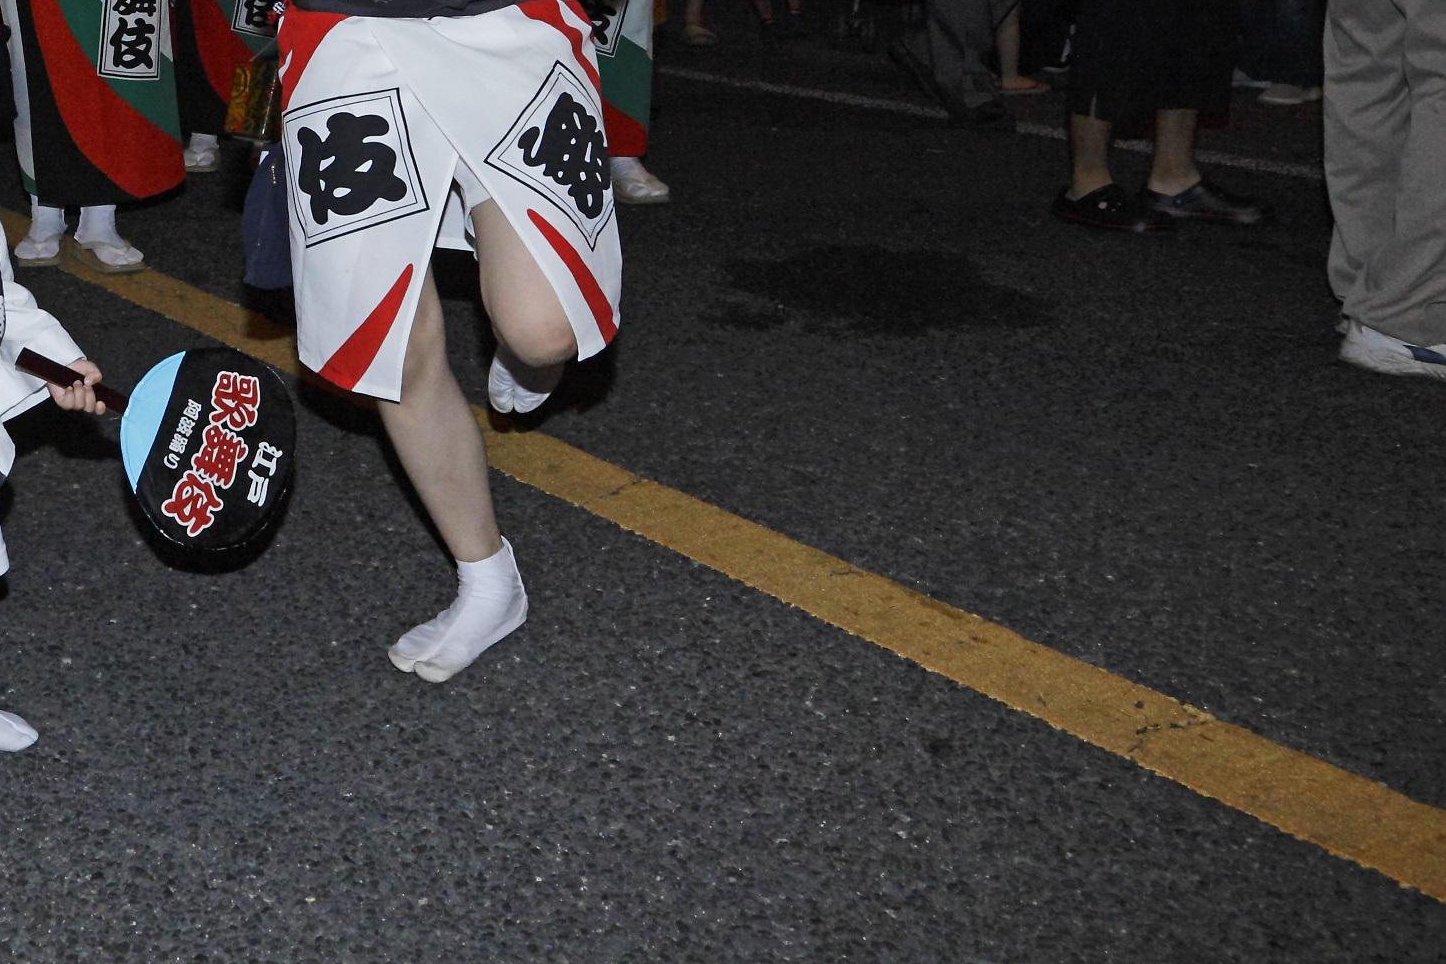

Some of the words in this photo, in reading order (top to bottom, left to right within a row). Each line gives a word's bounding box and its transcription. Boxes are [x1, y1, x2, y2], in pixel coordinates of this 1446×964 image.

[161, 370, 261, 537] 歌舞伎
[163, 398, 202, 469] 阿波踊り
[247, 441, 283, 507] 江戸
